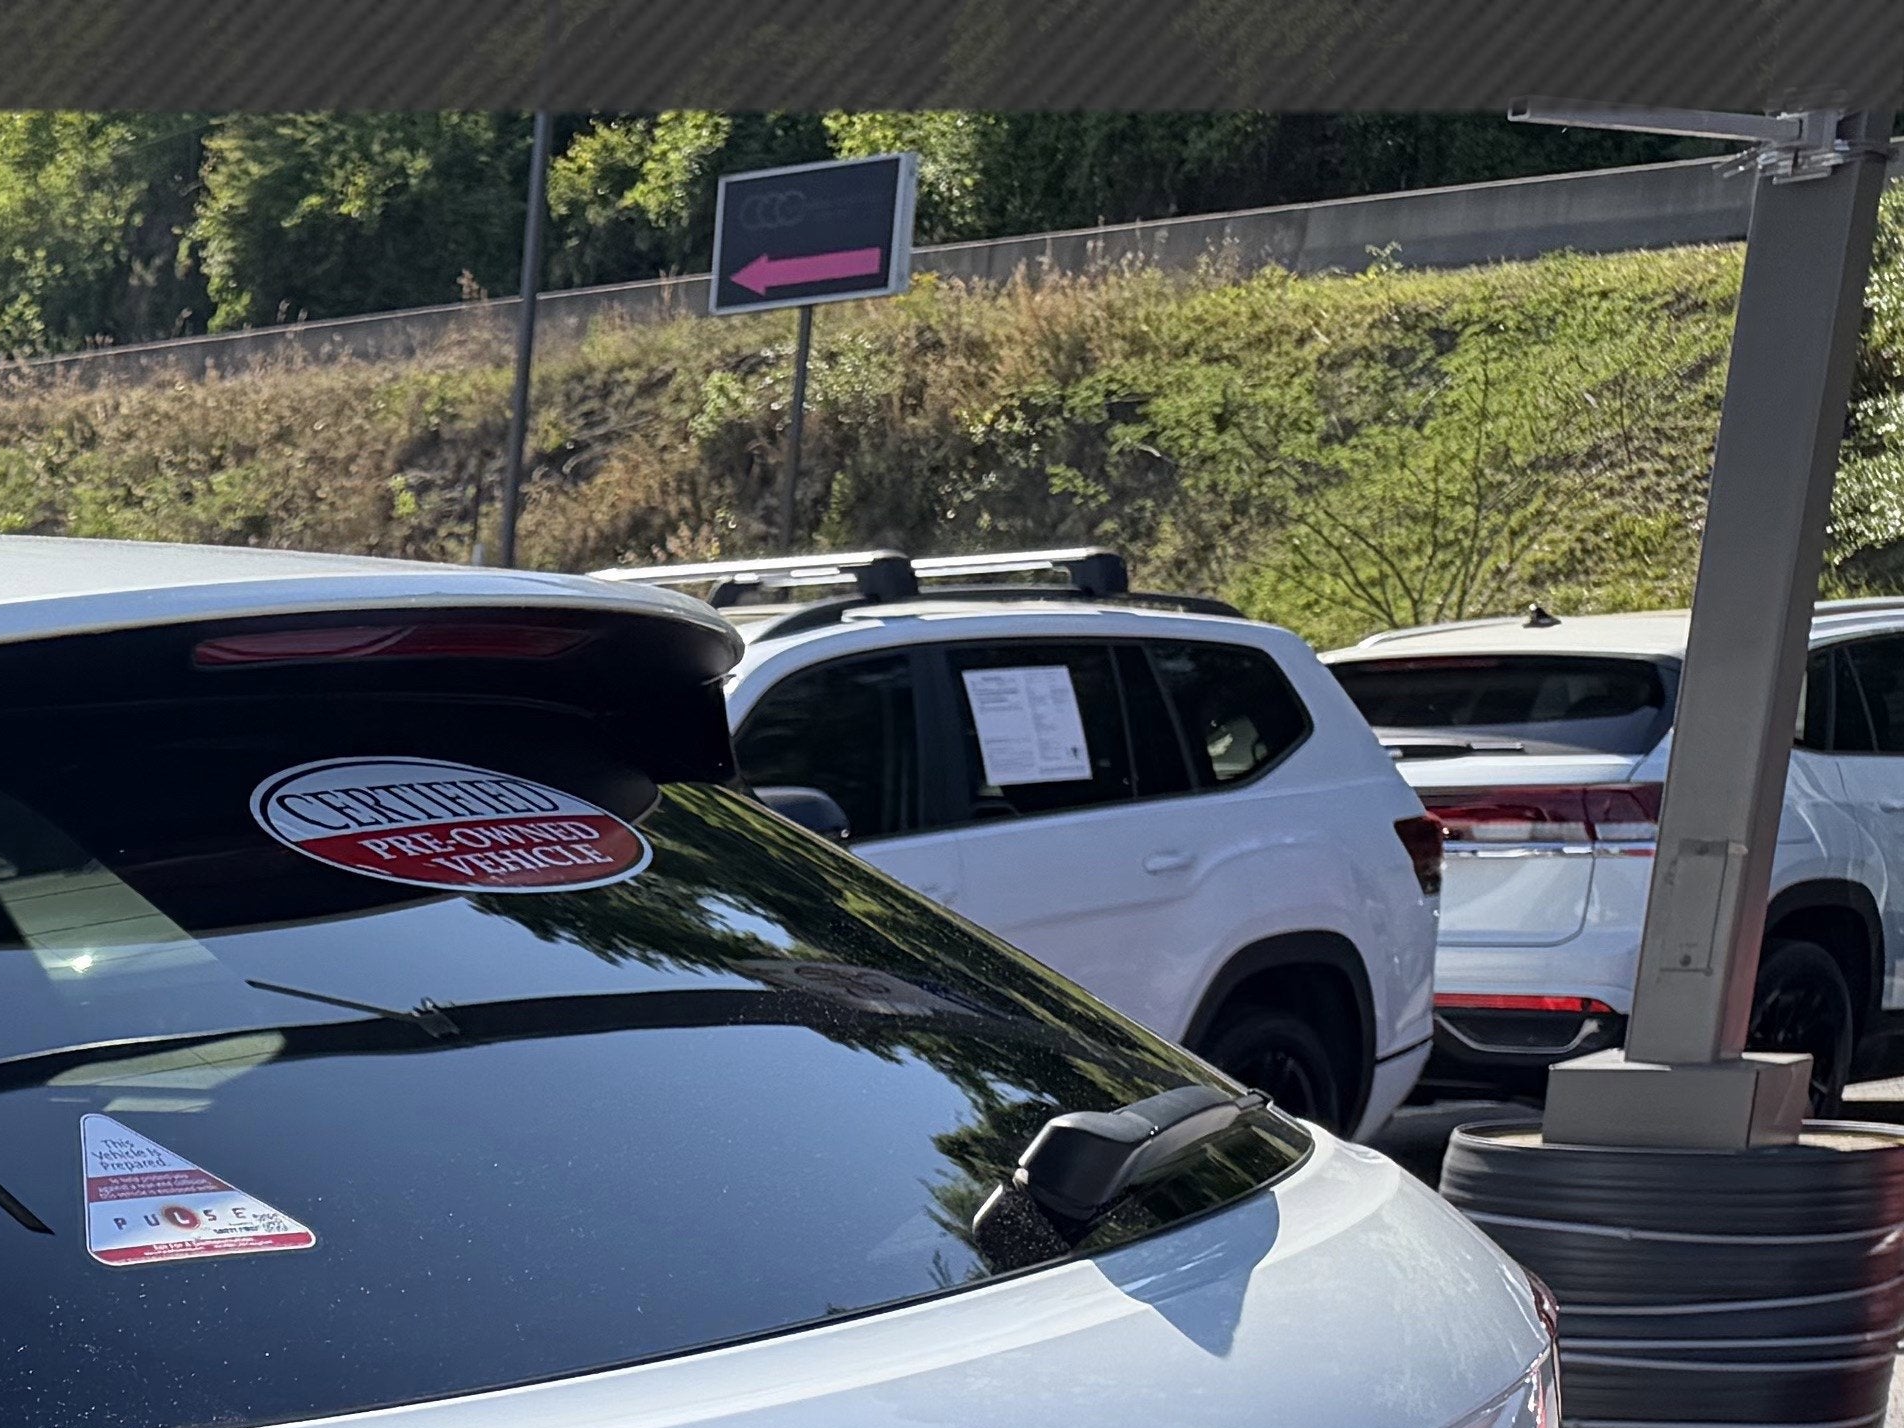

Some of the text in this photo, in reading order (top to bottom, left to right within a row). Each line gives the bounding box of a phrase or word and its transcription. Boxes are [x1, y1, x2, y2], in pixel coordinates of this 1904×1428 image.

[275, 778, 560, 832] CERTIFIED
[357, 820, 601, 862] PRE-OWNED
[430, 843, 615, 878] VEHICLE
[90, 1149, 146, 1161] Vehicle
[102, 1139, 134, 1149] This
[113, 1207, 247, 1231] PULSE
